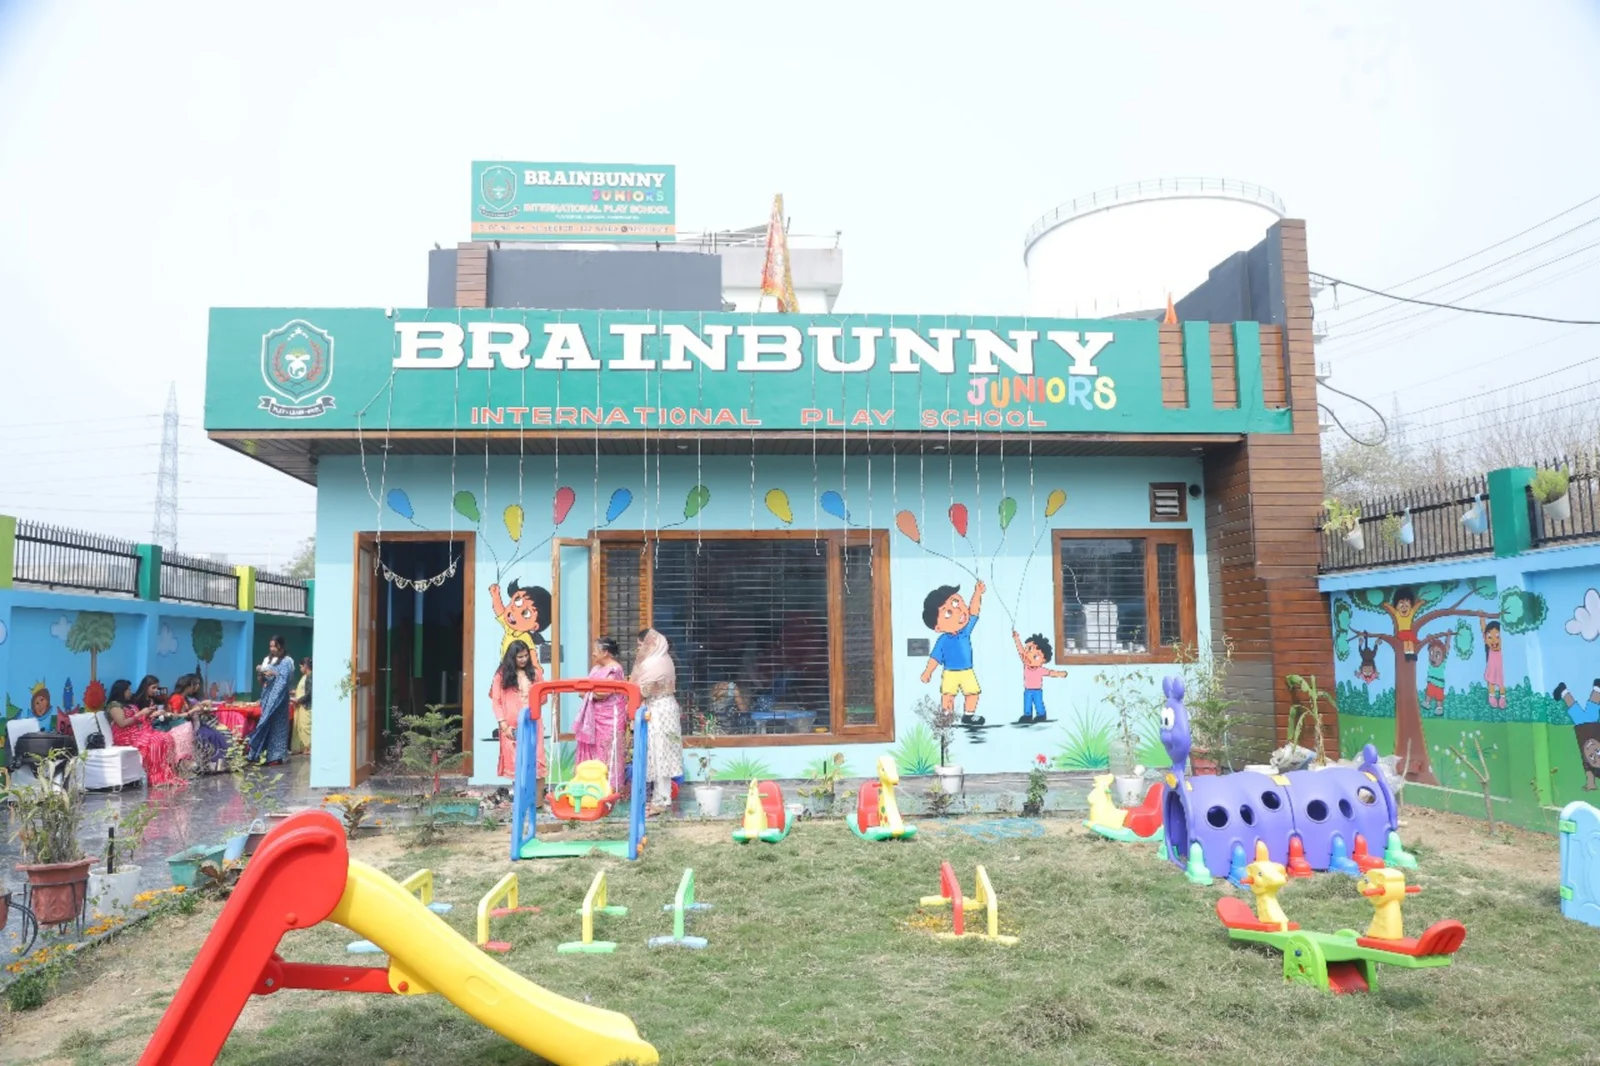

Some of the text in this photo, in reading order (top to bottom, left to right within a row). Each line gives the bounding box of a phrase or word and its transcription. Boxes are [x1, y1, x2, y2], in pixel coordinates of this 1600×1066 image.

[523, 170, 666, 188] BRAINBUNNY
[591, 189, 665, 202] JUNIORS
[523, 203, 601, 214] INTERNATIONAL
[604, 204, 628, 214] PLAY
[629, 204, 670, 215] SCHOOL
[393, 321, 1116, 376] BRAINBUNNY
[967, 376, 1117, 411] JUNIORS
[470, 406, 1047, 428] INTERNATIONAL PLAY SCHOOL
